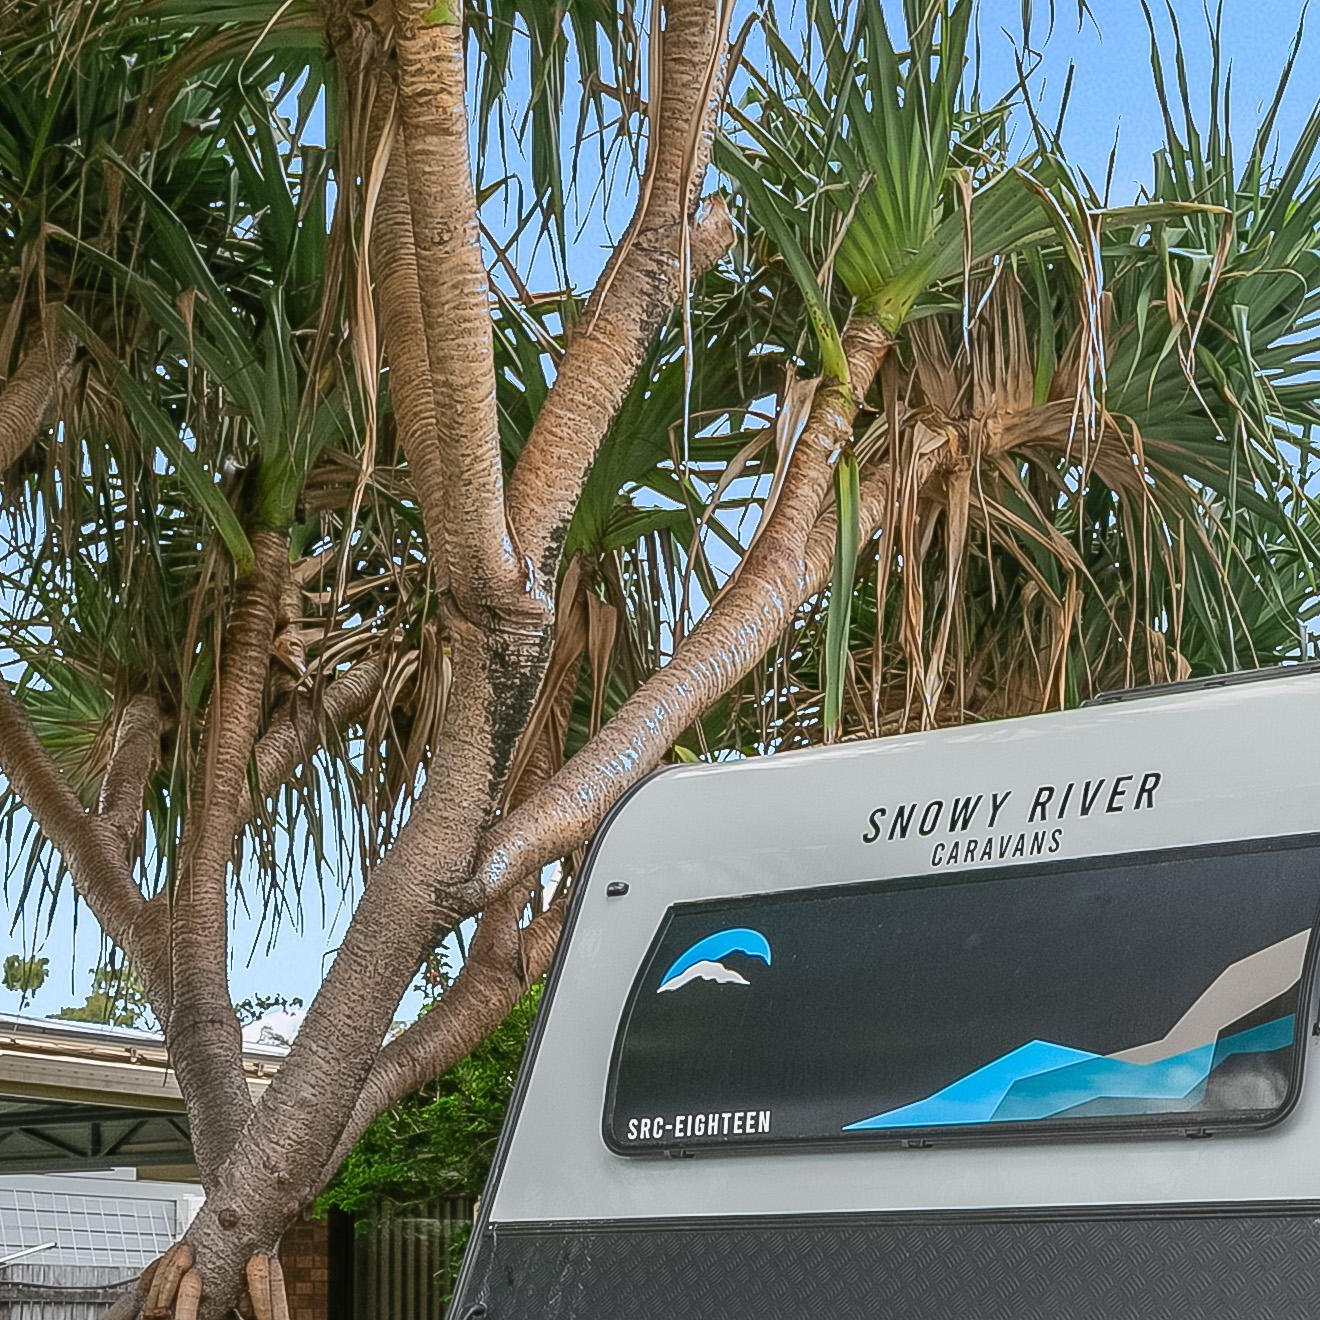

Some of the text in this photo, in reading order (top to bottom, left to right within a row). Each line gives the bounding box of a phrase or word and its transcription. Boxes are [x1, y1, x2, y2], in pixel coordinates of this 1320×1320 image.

[862, 772, 1162, 844] SNOWY RIVER
[931, 829, 1063, 867] CARAVANS
[627, 1110, 771, 1140] SRC-EIGHTEEN
